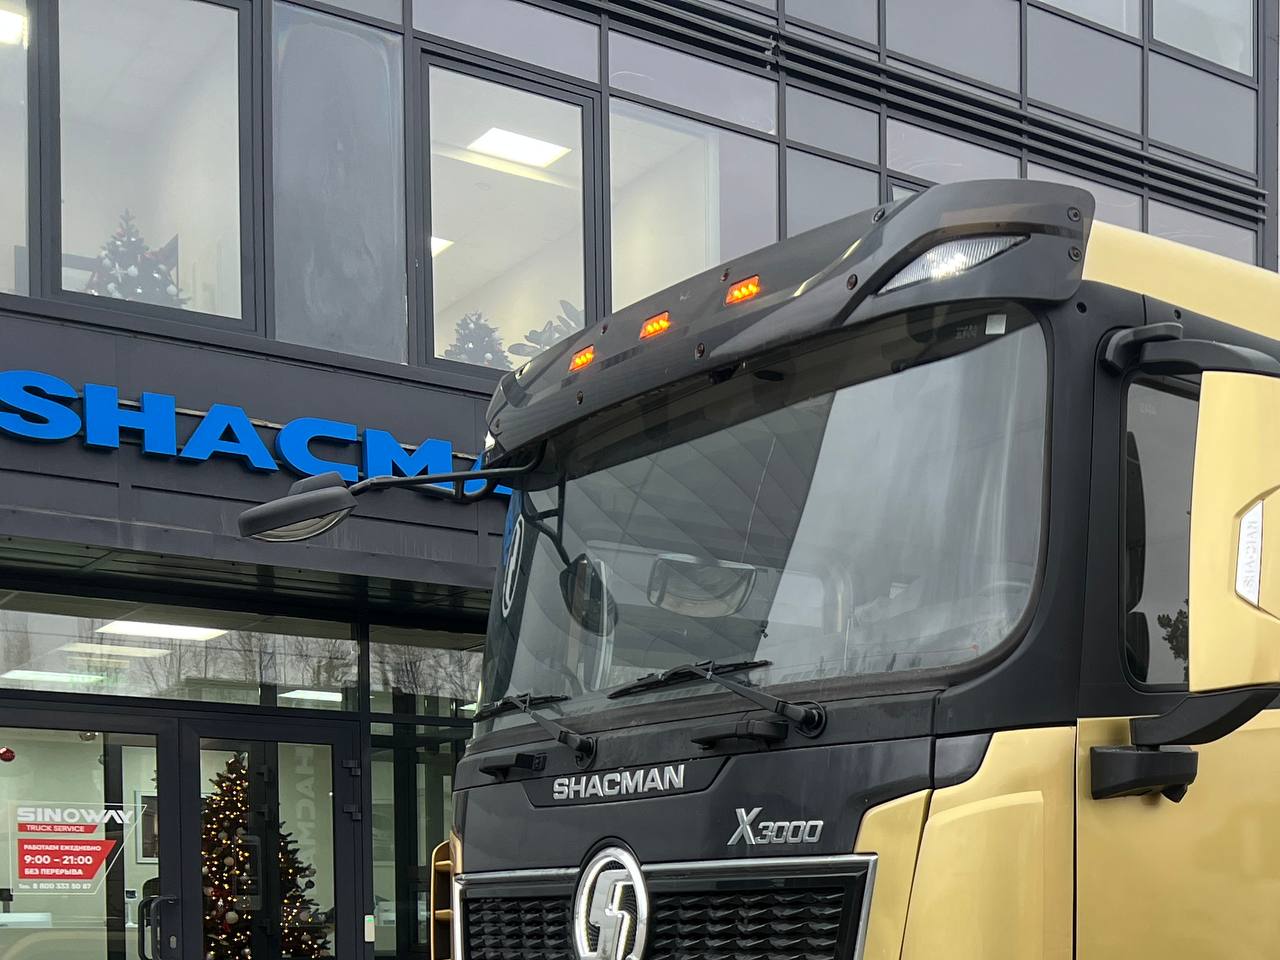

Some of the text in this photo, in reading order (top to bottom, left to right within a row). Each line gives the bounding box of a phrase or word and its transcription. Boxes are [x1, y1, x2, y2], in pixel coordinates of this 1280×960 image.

[552, 764, 685, 800] SHACMAN
[16, 807, 133, 824] SINOWAY
[26, 824, 85, 833] TRUCK SERVICE
[727, 807, 824, 846] X3000
[24, 855, 51, 864] 9:00
[62, 855, 93, 864] 21:00
[40, 868, 83, 876] ПЕРЕРЫВА
